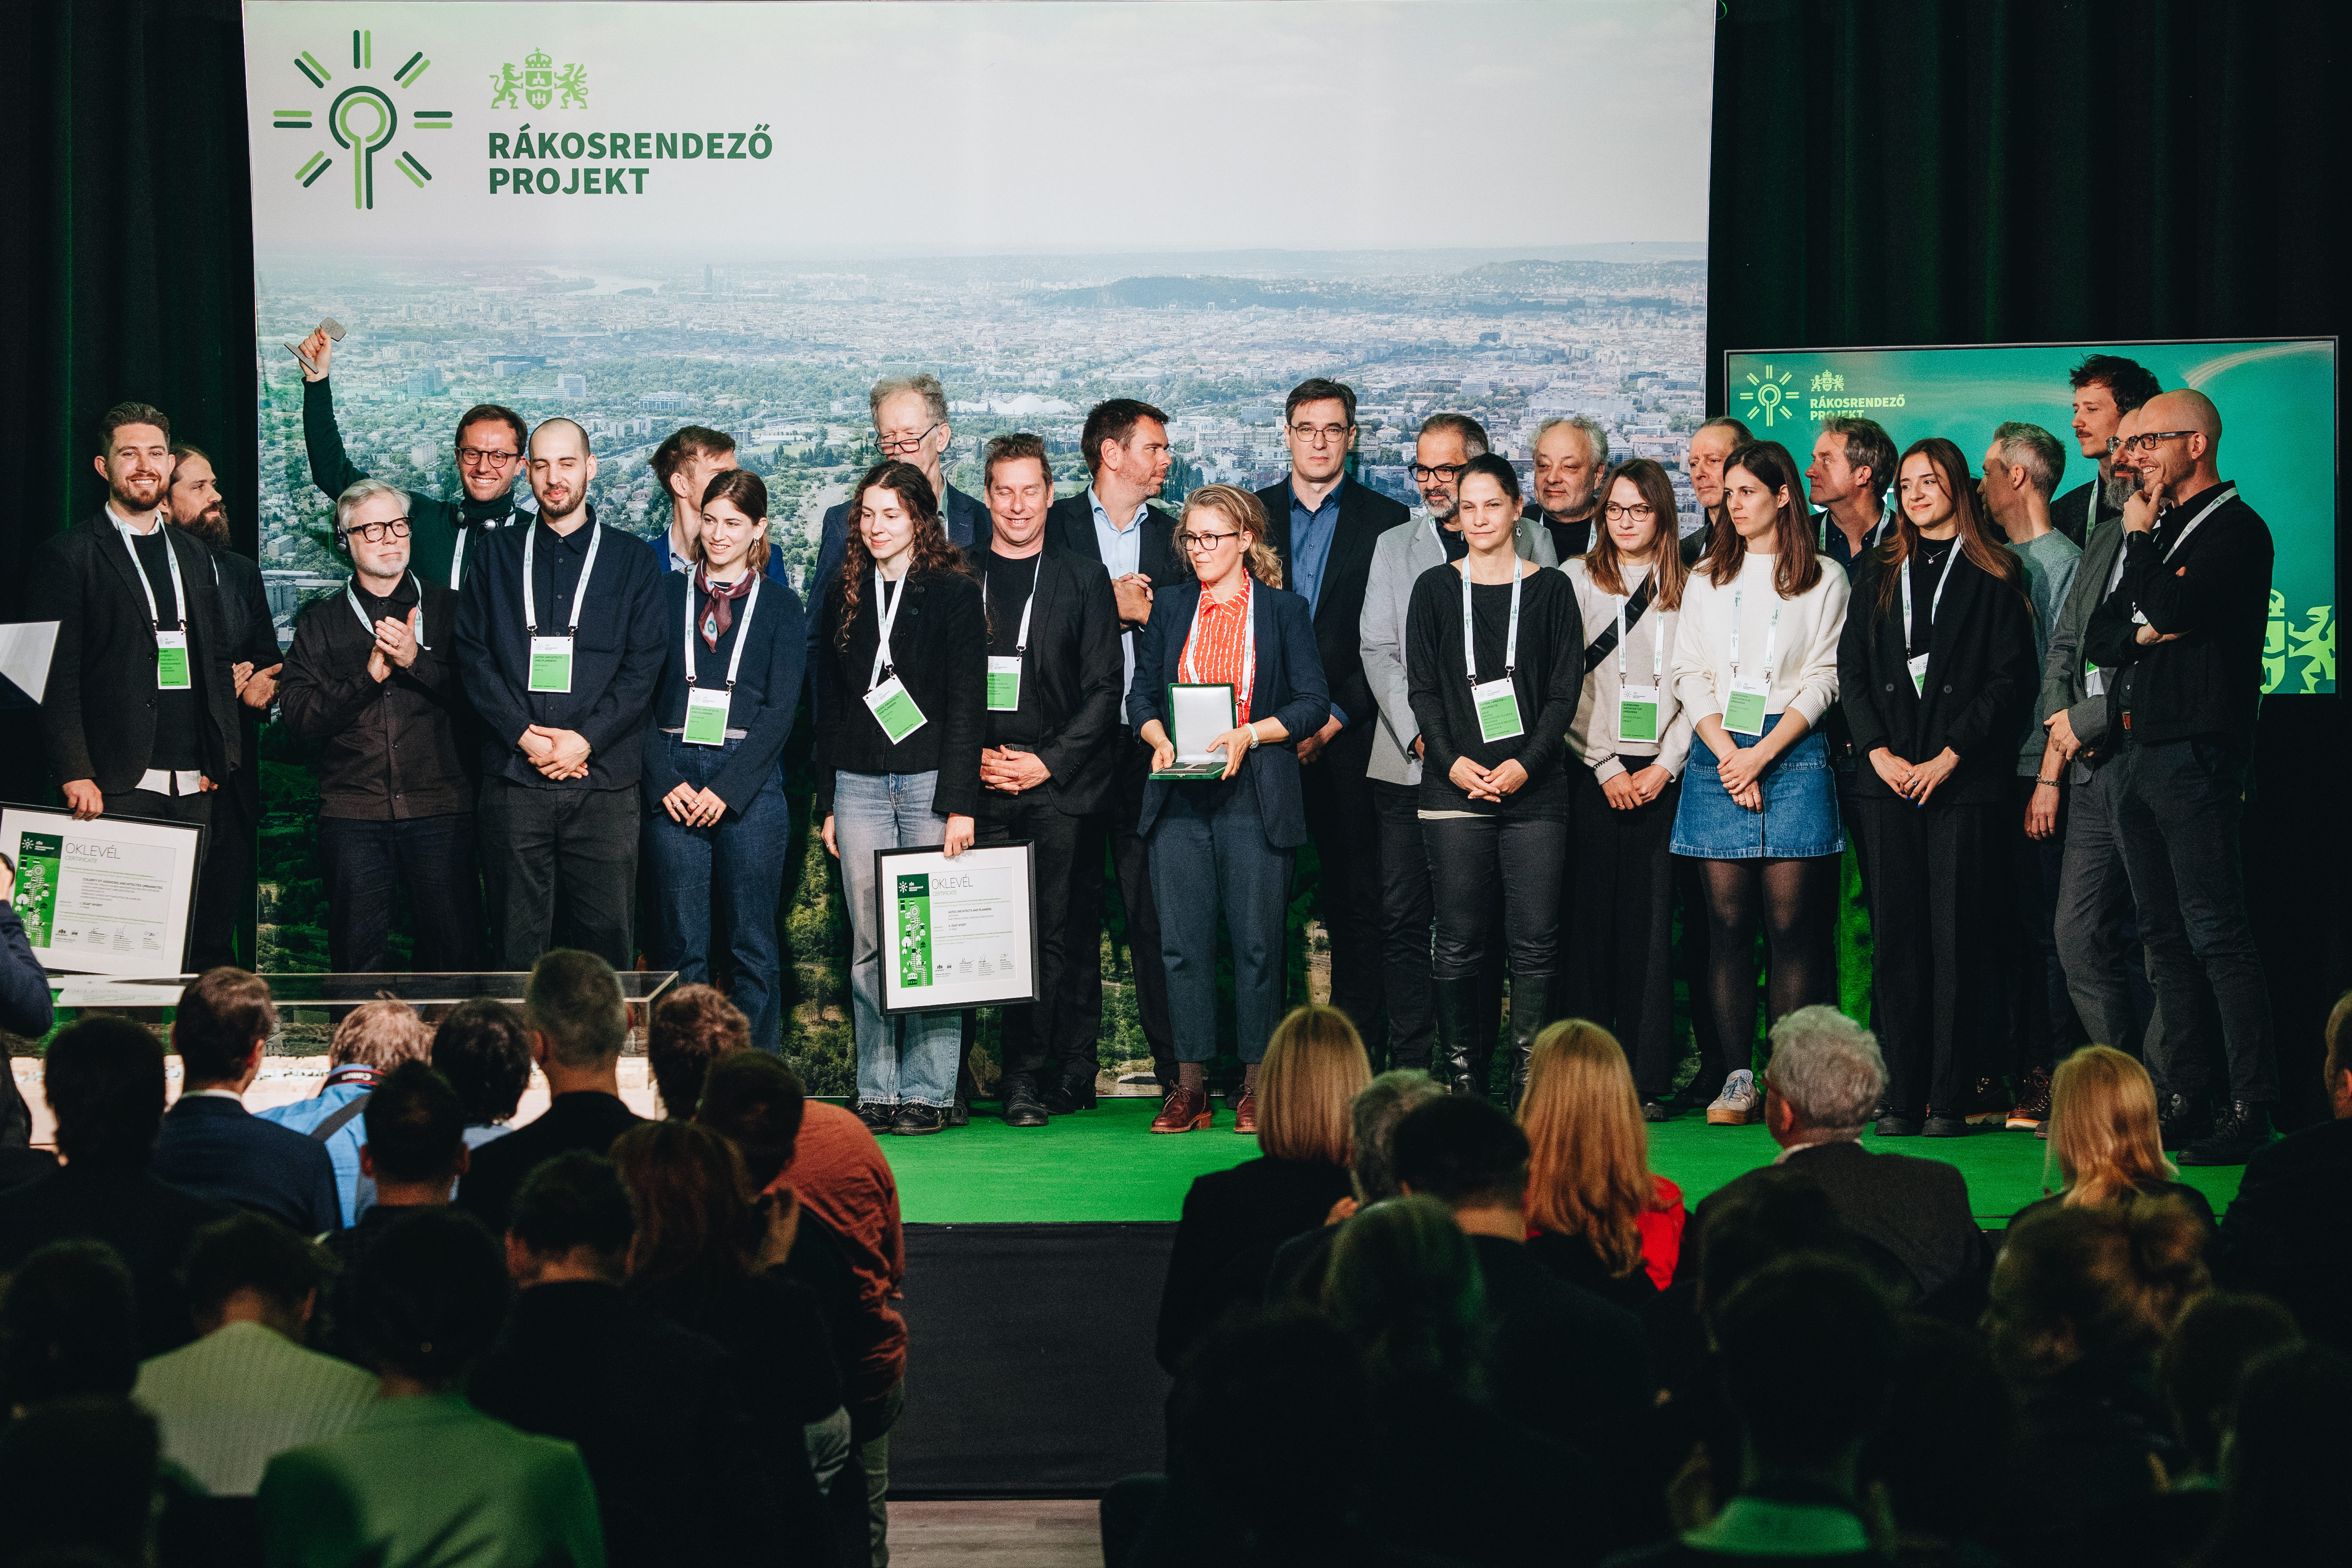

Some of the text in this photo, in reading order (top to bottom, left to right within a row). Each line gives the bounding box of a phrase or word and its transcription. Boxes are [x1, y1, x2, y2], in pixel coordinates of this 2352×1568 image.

[489, 123, 772, 159] RÁKOSRENDEZŐ
[489, 168, 649, 195] PROJEKT
[1811, 394, 1905, 408] RÁKOSRENDEZŐ
[884, 695, 899, 706] ARCHITECTS
[884, 701, 897, 711] PLANNERS
[65, 843, 120, 859] OKLEVÉL
[932, 874, 973, 889] OKLEVÉL
[342, 1072, 372, 1081] Canon
